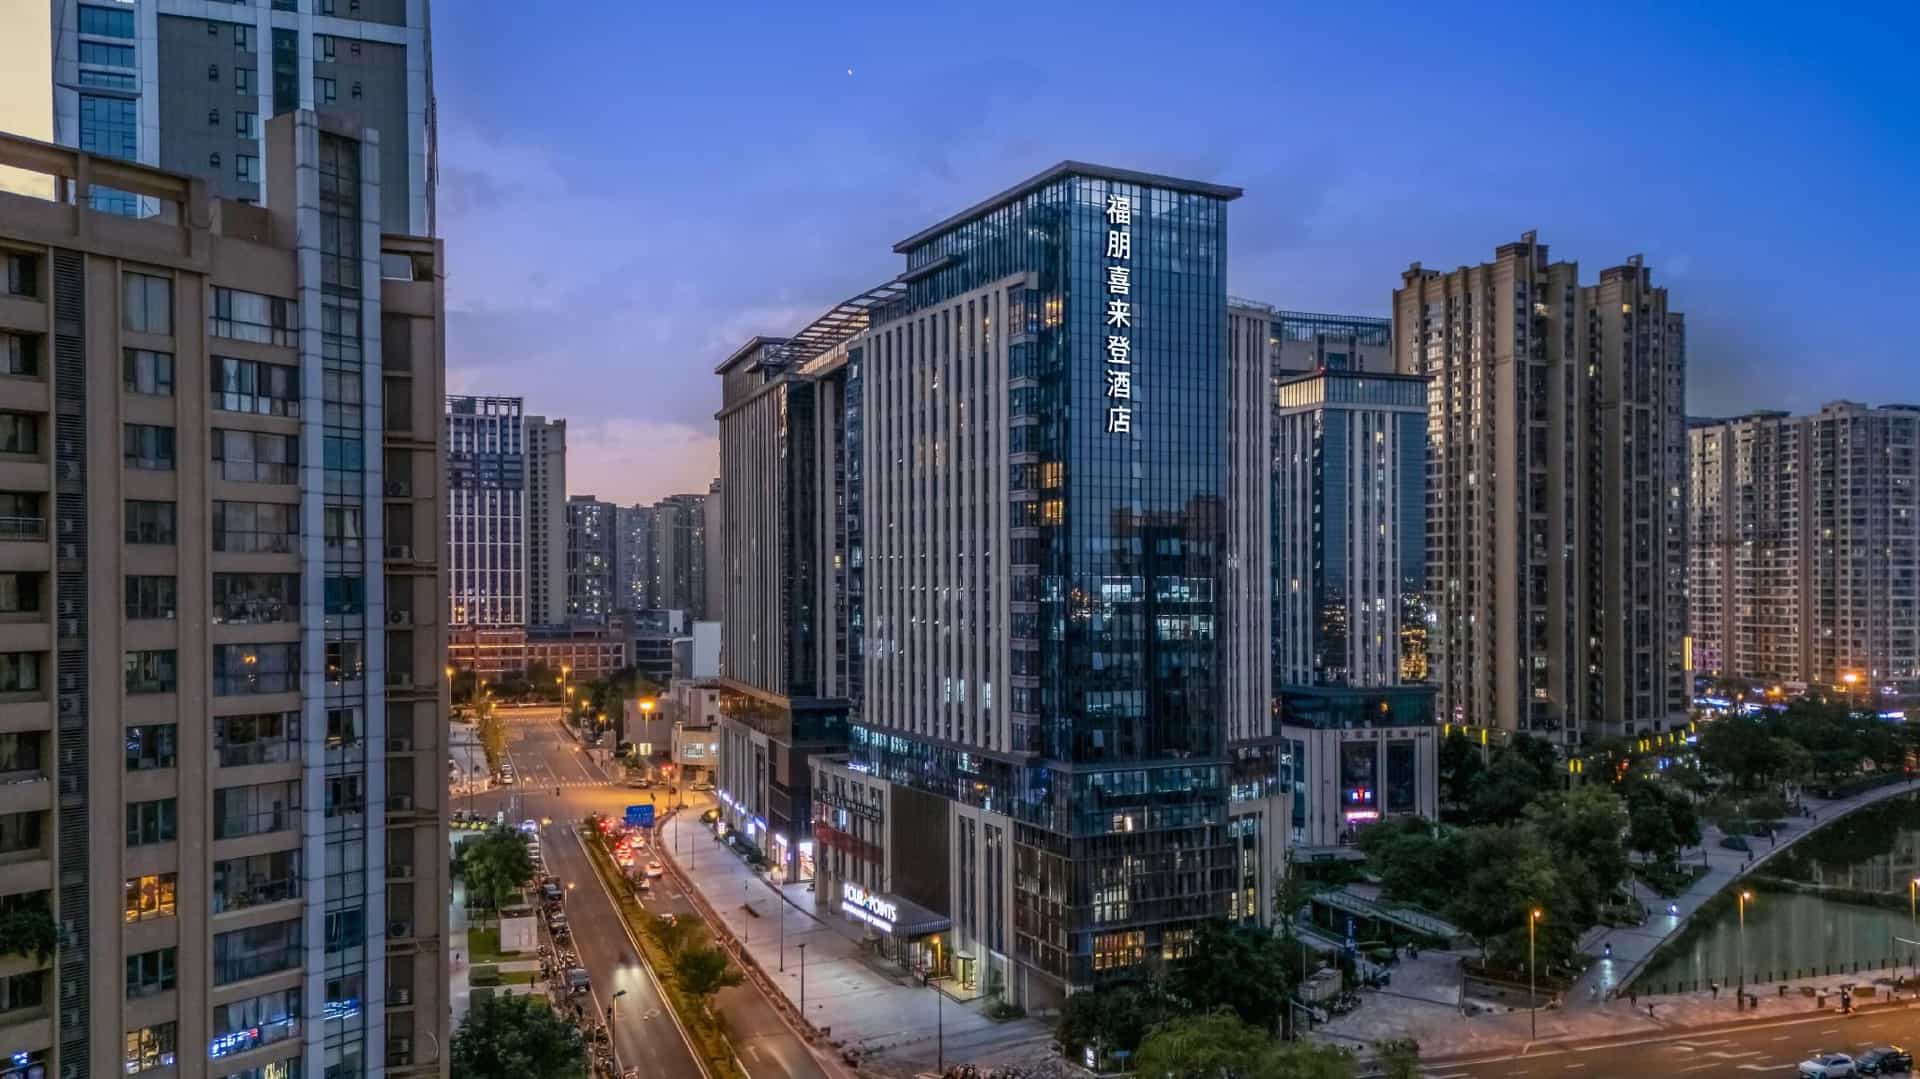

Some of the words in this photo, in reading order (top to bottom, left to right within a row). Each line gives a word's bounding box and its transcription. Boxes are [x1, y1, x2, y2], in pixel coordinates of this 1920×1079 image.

[1106, 194, 1131, 433] 福朋喜来登酒店
